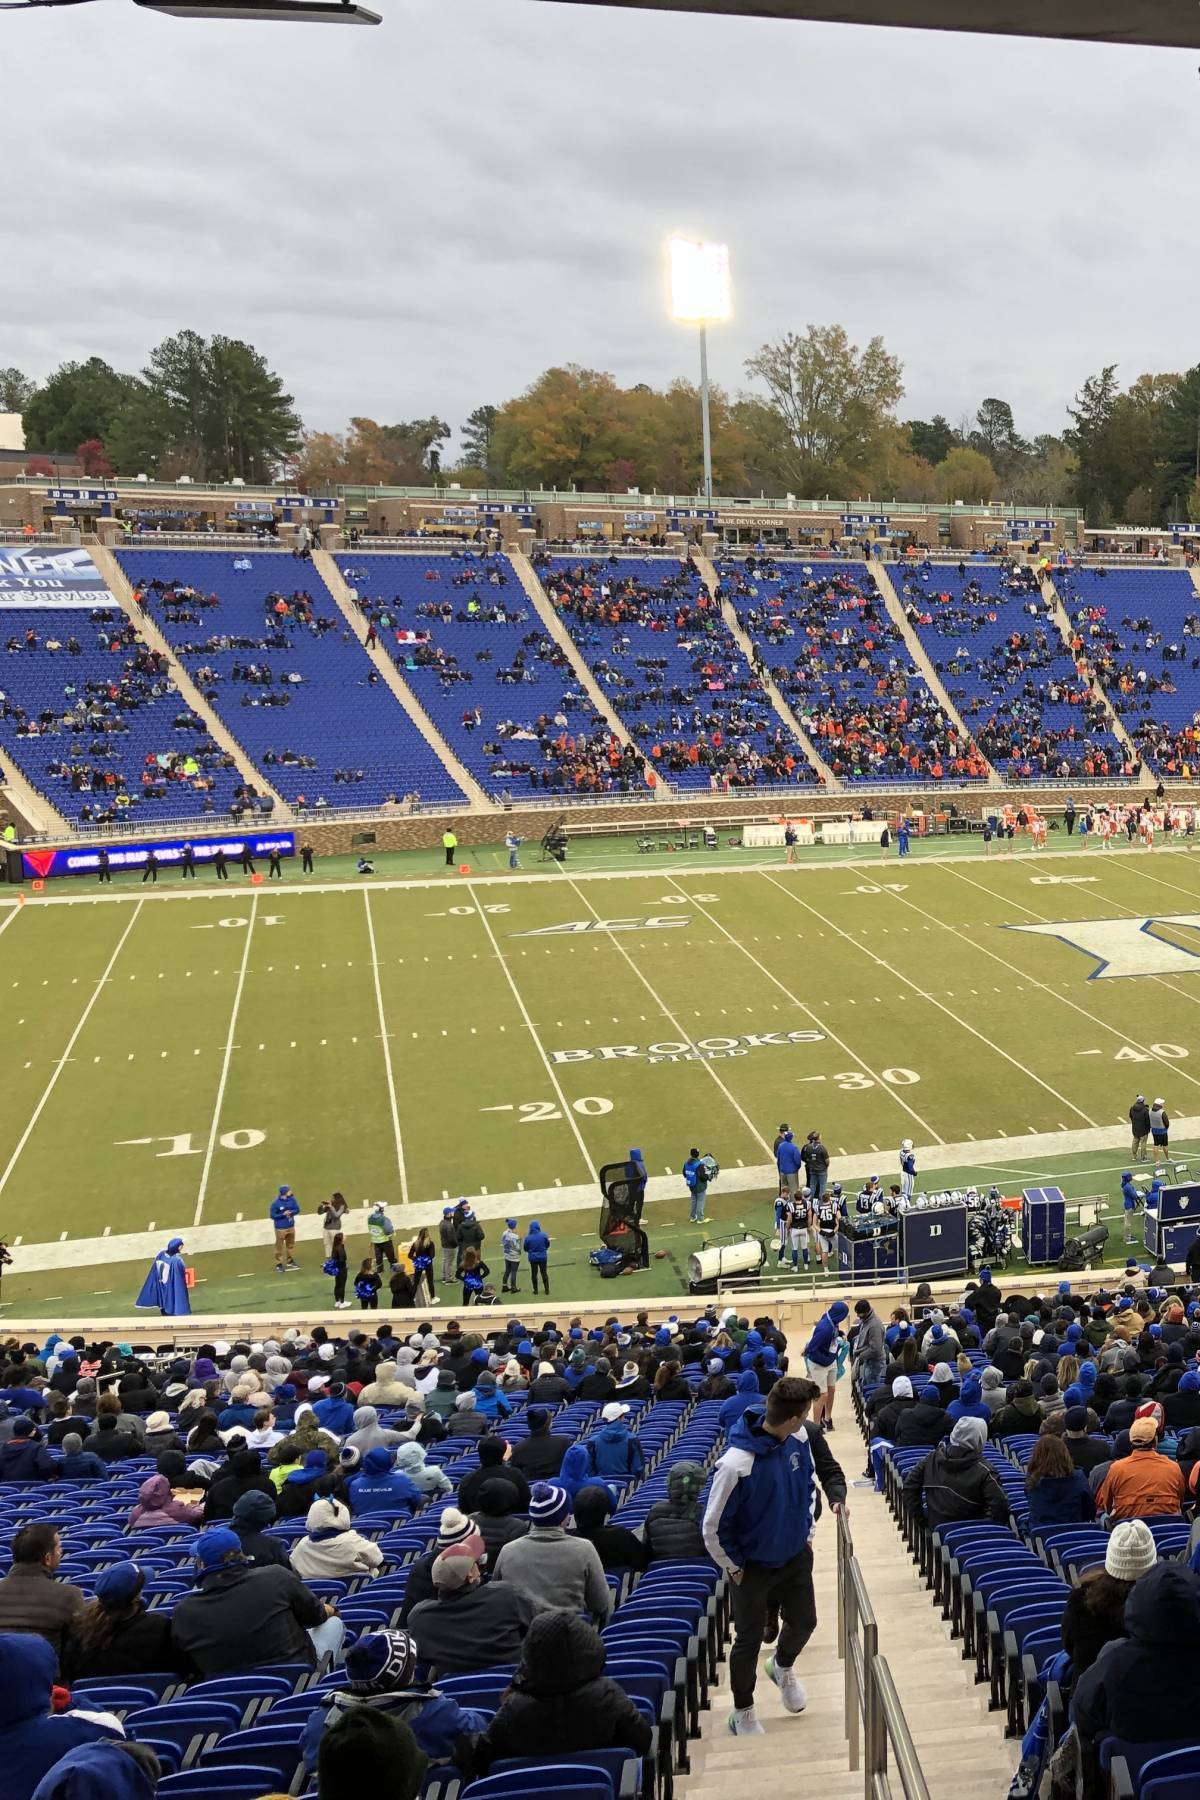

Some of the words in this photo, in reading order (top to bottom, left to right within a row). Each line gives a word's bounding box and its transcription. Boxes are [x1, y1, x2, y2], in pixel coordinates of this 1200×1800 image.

[15, 578, 65, 588] You
[19, 590, 111, 601] Service
[447, 903, 512, 915] 20
[218, 915, 287, 928] 10
[503, 915, 695, 938] ACC
[548, 1029, 829, 1065] BROOKS
[1113, 1043, 1190, 1063] 40
[647, 1048, 749, 1065] FIELD
[831, 1068, 922, 1091] 30
[518, 1096, 614, 1123] 20
[155, 1129, 267, 1158] 10
[820, 1209, 832, 1220] 46
[929, 1224, 942, 1237] D
